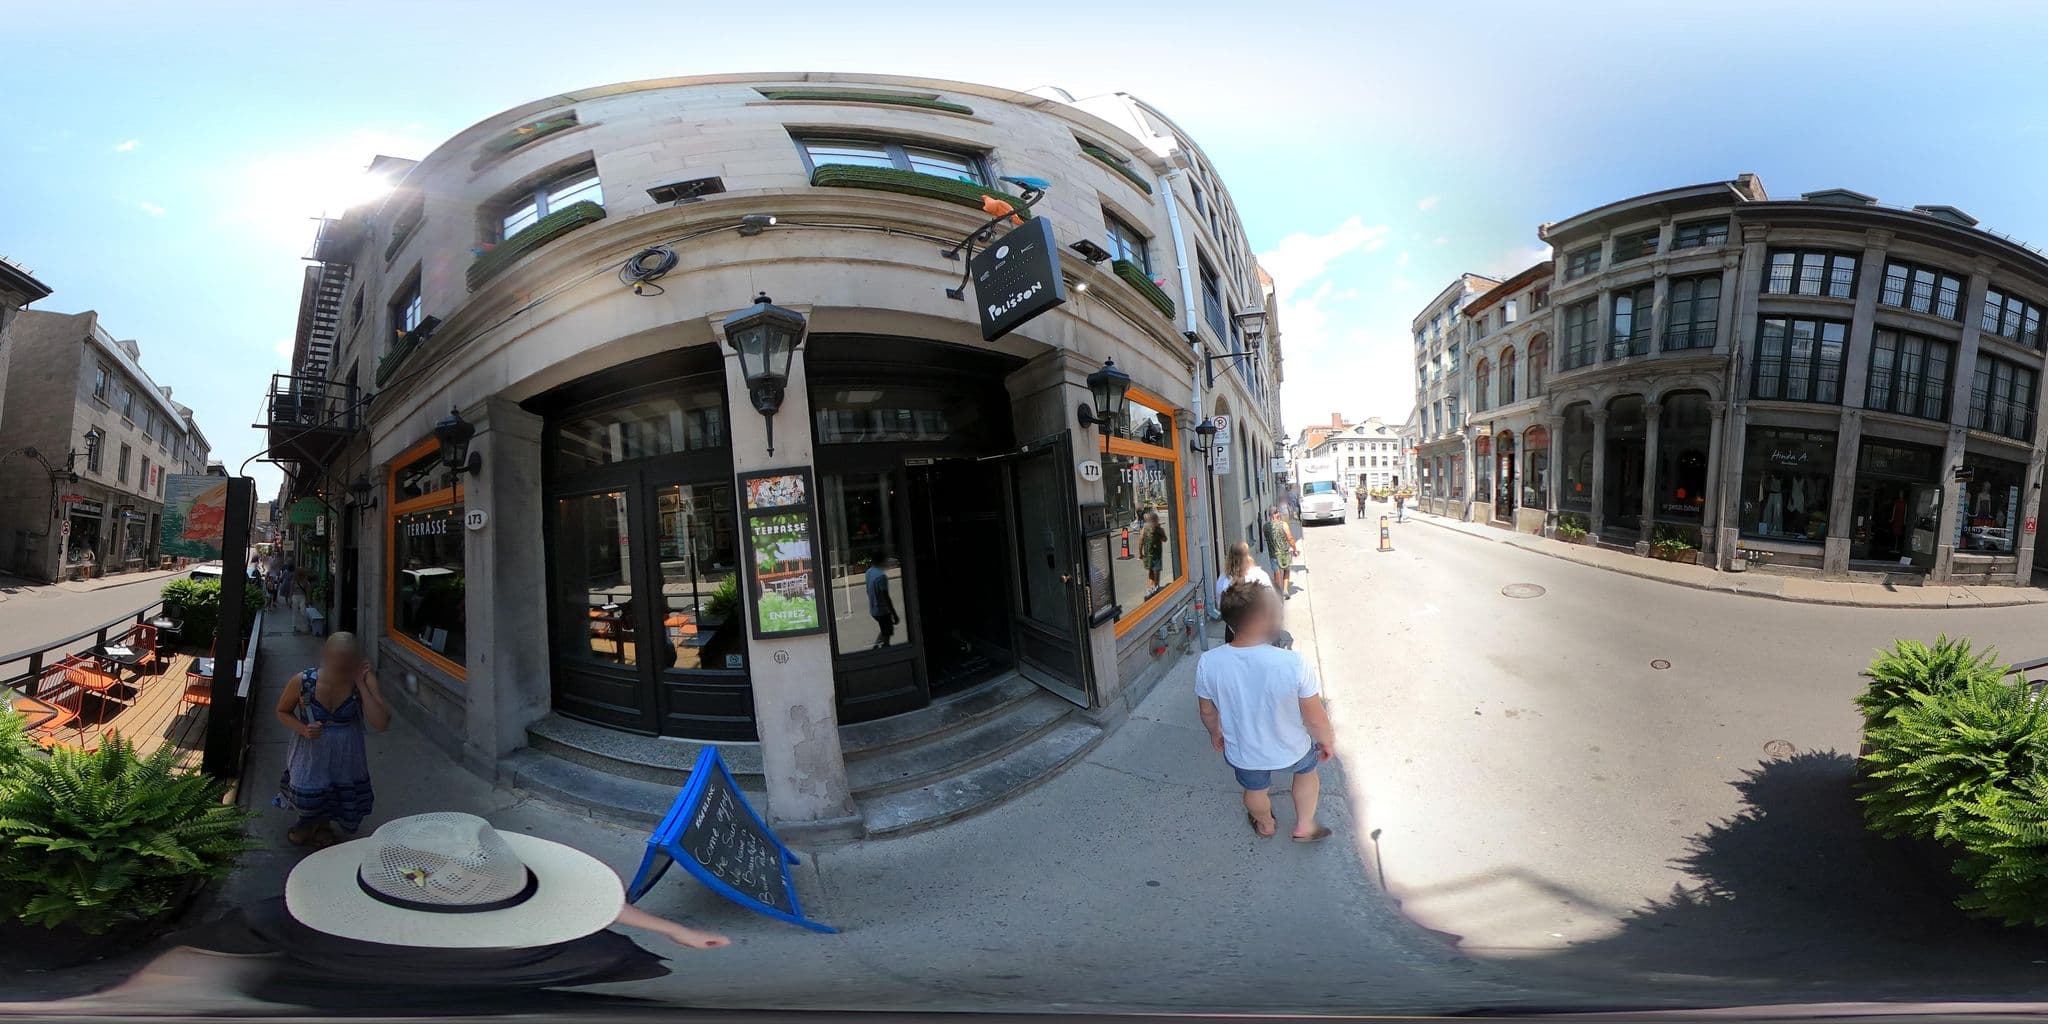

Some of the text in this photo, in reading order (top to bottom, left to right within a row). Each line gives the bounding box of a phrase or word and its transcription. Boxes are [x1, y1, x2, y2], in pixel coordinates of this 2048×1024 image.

[1217, 446, 1224, 457] P
[1085, 465, 1099, 476] 171
[1120, 468, 1162, 484] TERRASSE
[468, 513, 482, 525] 173
[407, 519, 447, 537] TERRASSE
[754, 522, 806, 536] TERRASSE
[694, 827, 720, 865] Come
[713, 856, 729, 878] the
